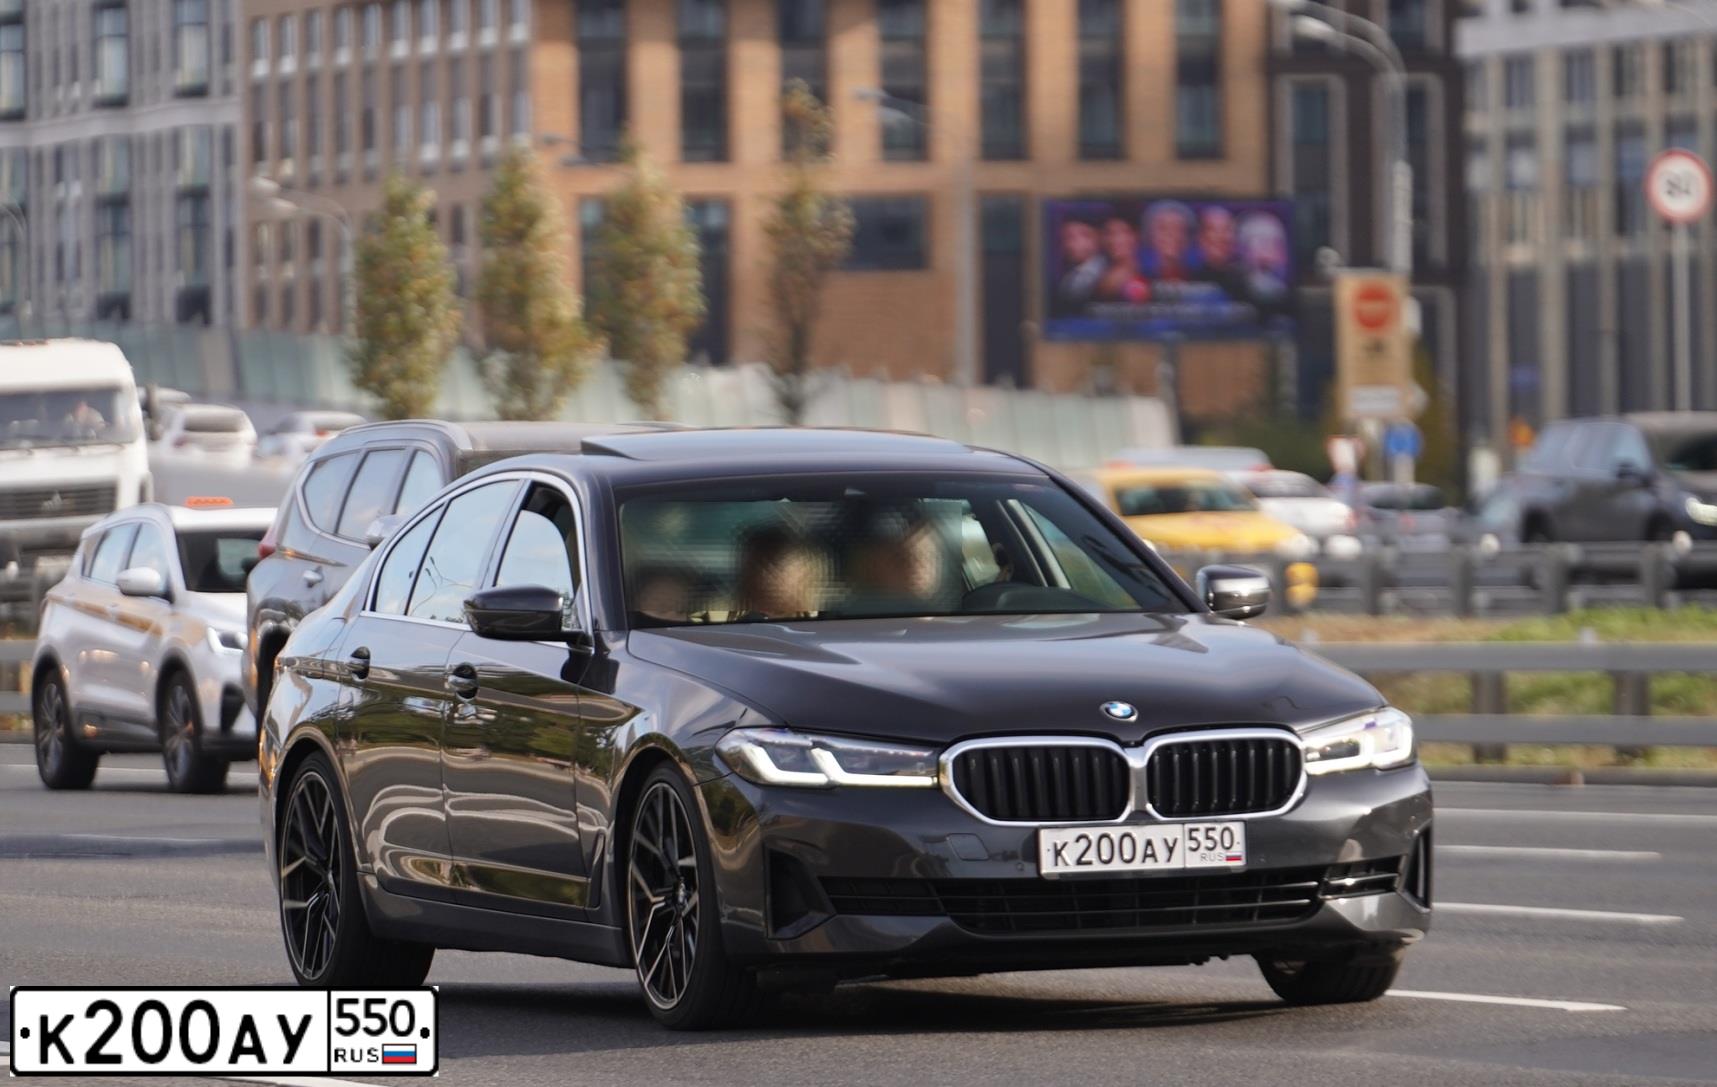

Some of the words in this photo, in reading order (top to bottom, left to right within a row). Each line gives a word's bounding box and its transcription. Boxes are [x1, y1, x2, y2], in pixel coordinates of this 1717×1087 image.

[1053, 831, 1178, 867] К200АУ
[1188, 826, 1235, 852] 550
[1200, 852, 1224, 863] RUS
